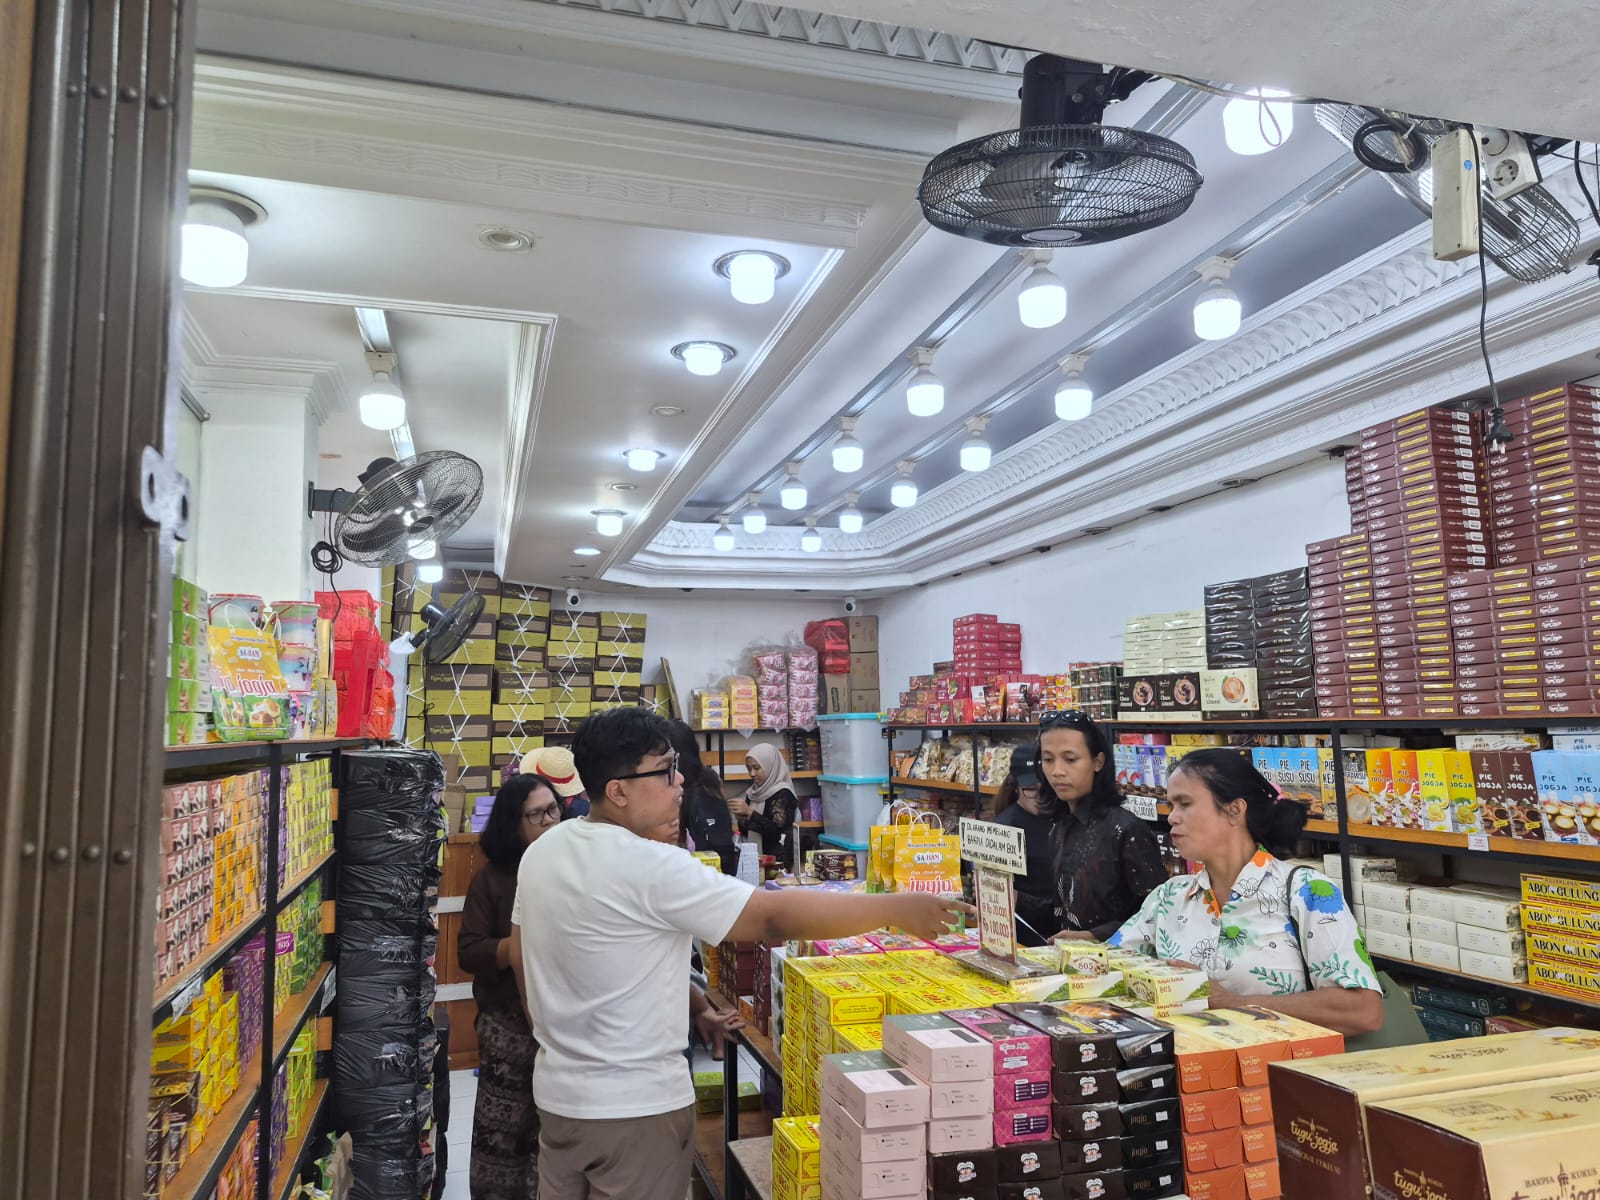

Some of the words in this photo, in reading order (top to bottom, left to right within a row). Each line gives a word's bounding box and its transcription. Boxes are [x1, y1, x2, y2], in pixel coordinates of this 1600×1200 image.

[236, 674, 275, 696] jogja
[1258, 759, 1267, 769] PIE
[1280, 760, 1289, 770] PIE
[1301, 760, 1310, 771] PIE
[1325, 761, 1335, 771] PIE
[1279, 771, 1295, 782] SUSU
[1299, 772, 1316, 783] SUSU
[1323, 772, 1335, 784] KEJ
[1479, 773, 1492, 781] PIE
[1477, 781, 1502, 789] JOGJA
[1507, 782, 1534, 790] JOGJA
[1539, 783, 1567, 791] JOGJA
[986, 837, 1006, 853] DIDALAM
[1006, 843, 1017, 855] BOX
[1557, 886, 1600, 902] GULUNG
[1534, 938, 1561, 953] ABON
[1562, 944, 1600, 961] GULUN
[1078, 962, 1094, 970] 805
[1071, 982, 1084, 990] 805
[1290, 1120, 1313, 1143] tugu
[1310, 1132, 1339, 1154] jogja
[1525, 1175, 1555, 1189] BAKPIA
[1570, 1167, 1598, 1180] KUKUS
[1393, 1170, 1423, 1198] tugu
